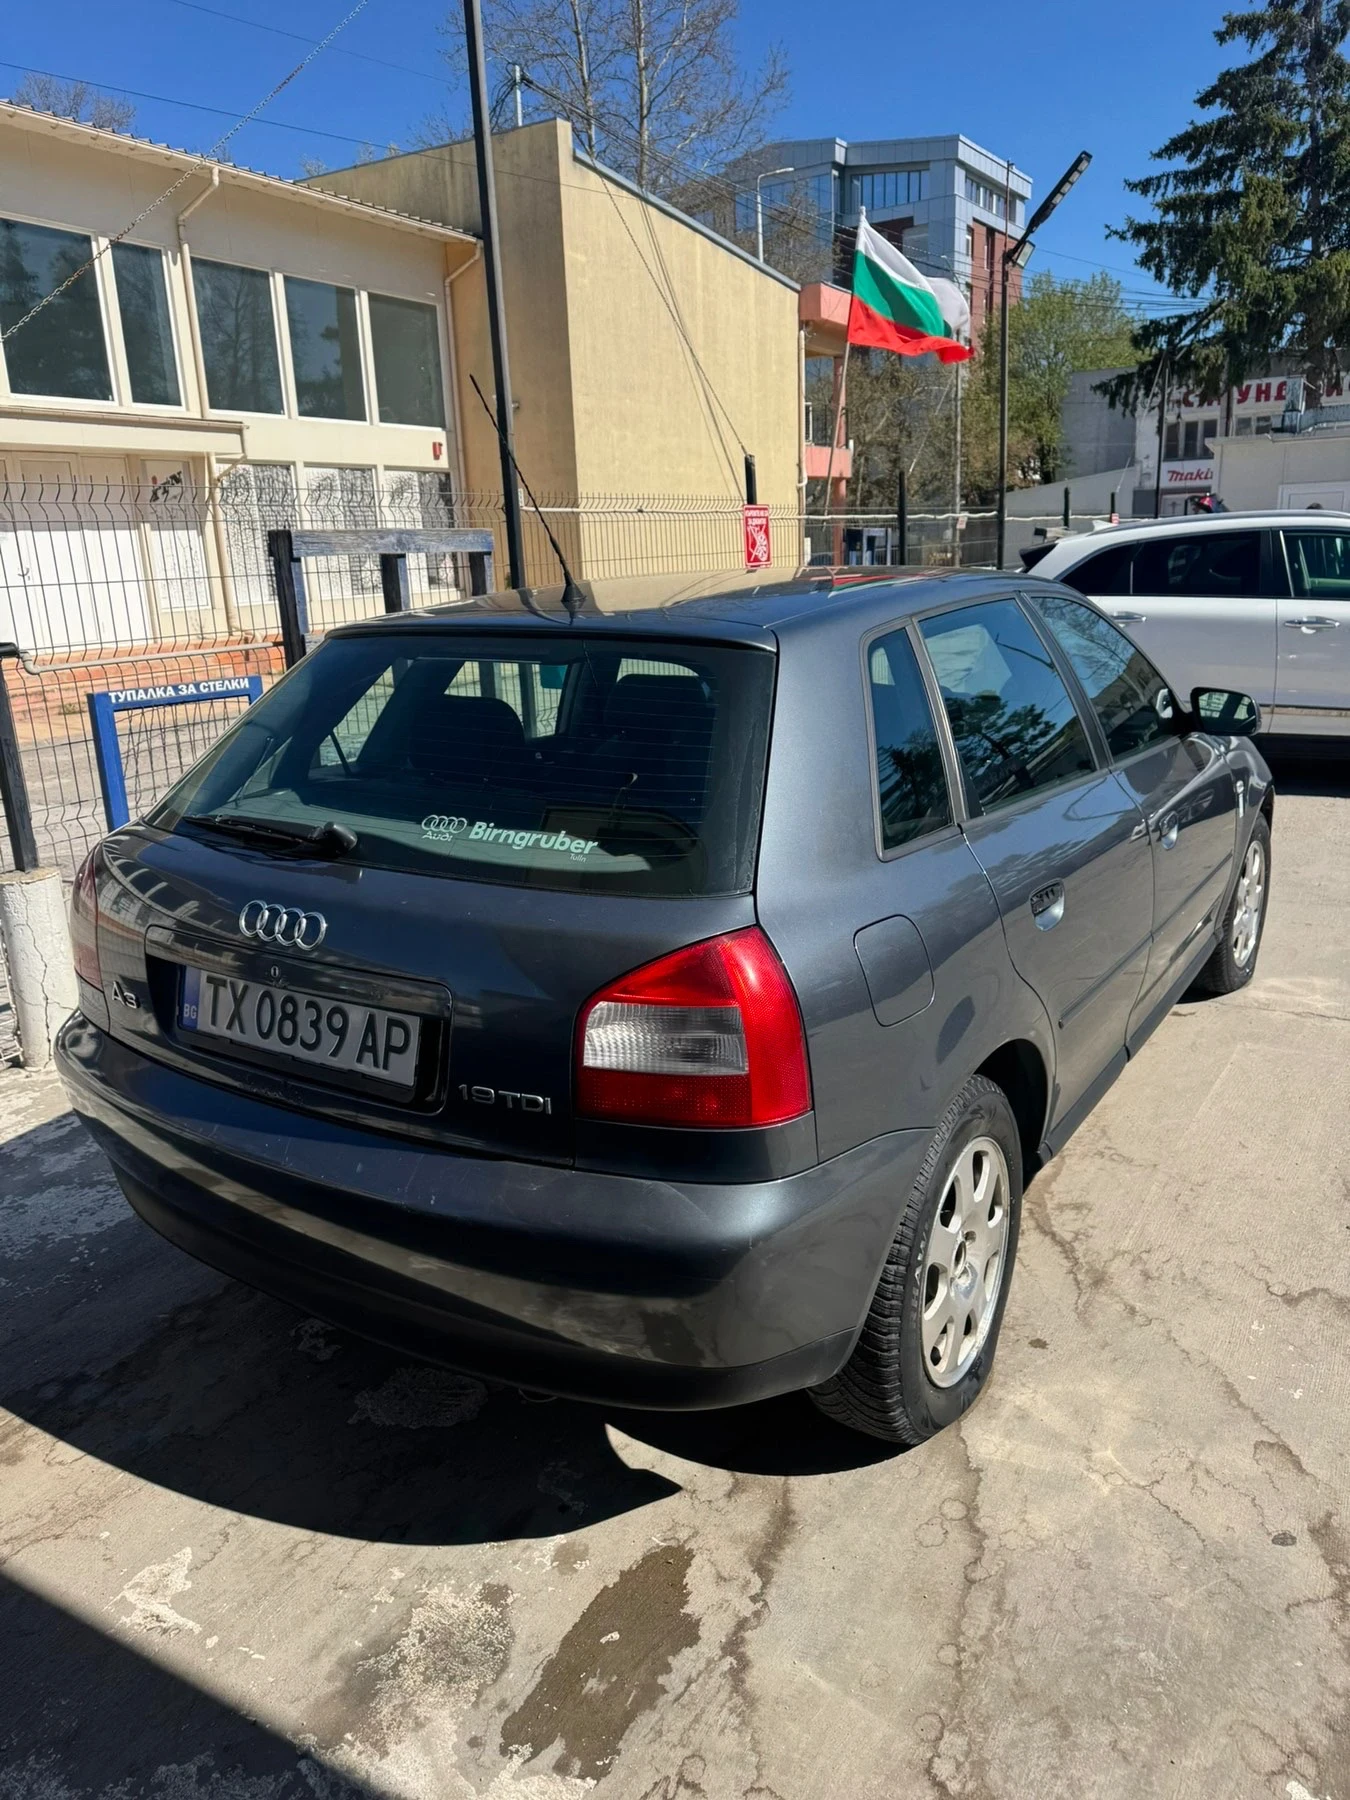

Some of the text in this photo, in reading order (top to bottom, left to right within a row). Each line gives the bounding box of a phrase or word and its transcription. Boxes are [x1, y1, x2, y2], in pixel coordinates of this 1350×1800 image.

[108, 677, 250, 703] ТУПАЛКА ЗА СТЕЛКИ
[421, 830, 453, 842] Audi
[468, 821, 598, 854] Birngruber
[112, 980, 137, 1009] A3
[183, 1003, 197, 1019] BG
